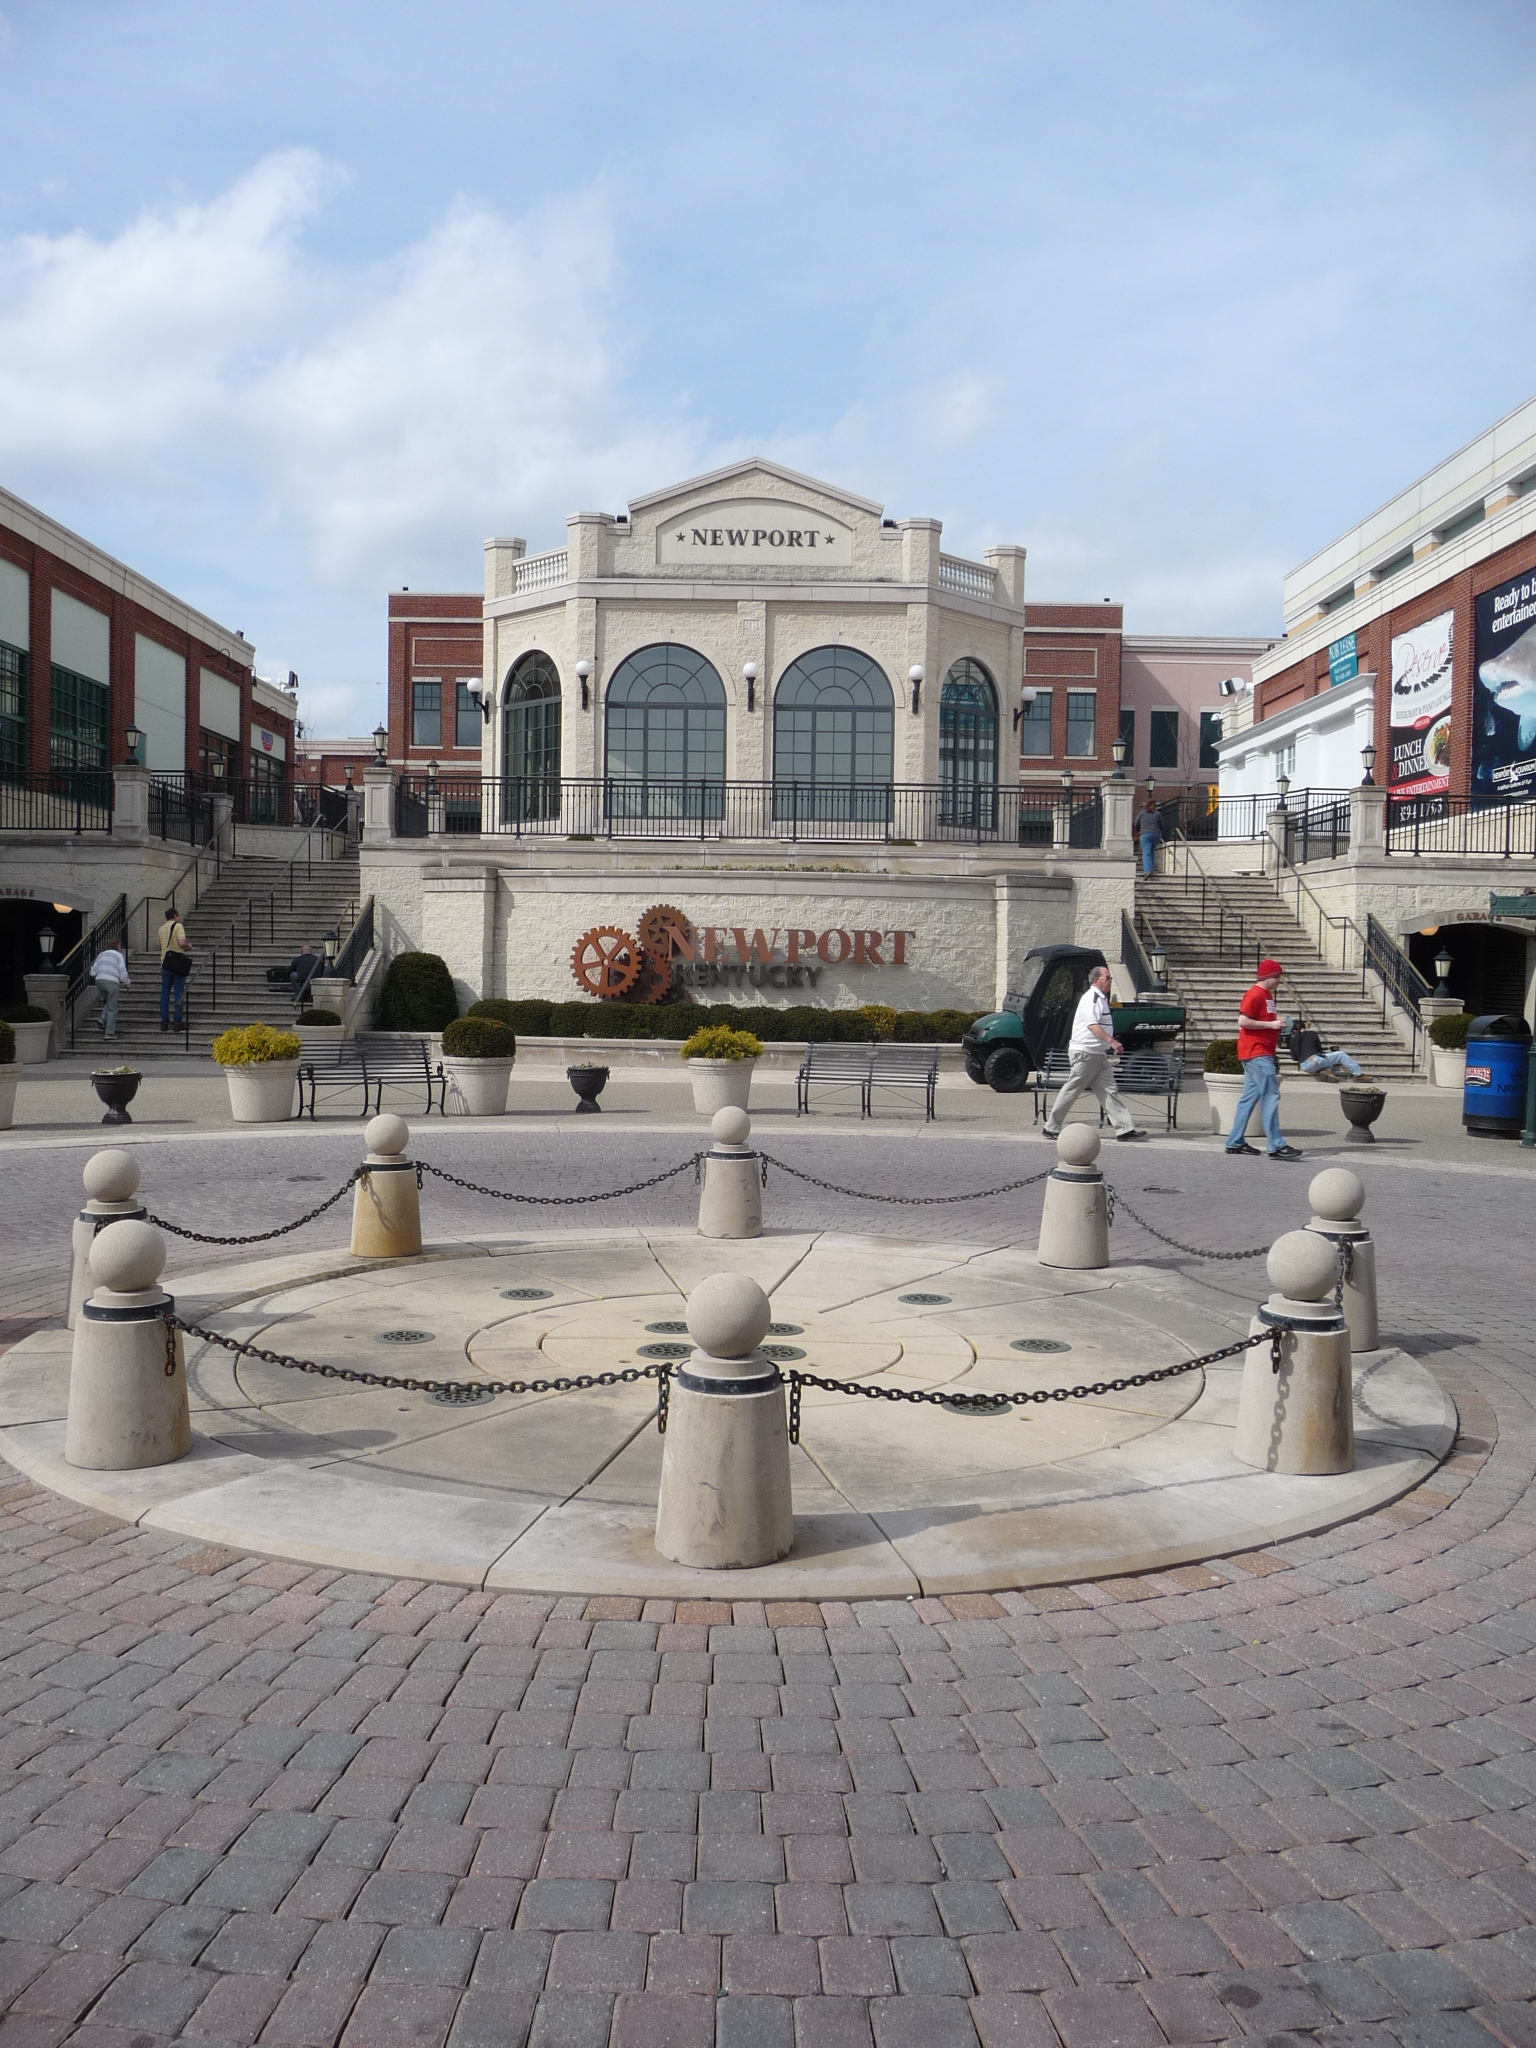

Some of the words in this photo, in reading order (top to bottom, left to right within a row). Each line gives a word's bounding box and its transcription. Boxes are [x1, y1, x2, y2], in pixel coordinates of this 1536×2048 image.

[691, 528, 820, 548] NEWPORT
[1494, 587, 1520, 614] Ready
[1521, 584, 1530, 601] to
[1329, 643, 1340, 660] FOR
[1340, 635, 1356, 655] LEASE
[1394, 739, 1422, 762] LUNCH
[1398, 754, 1430, 778] DINNER
[1406, 776, 1450, 796] ENTERTAINMENT
[663, 926, 916, 965] NEWPORT
[675, 964, 823, 988] KENTUCKY
[1134, 1023, 1181, 1031] RANGER
